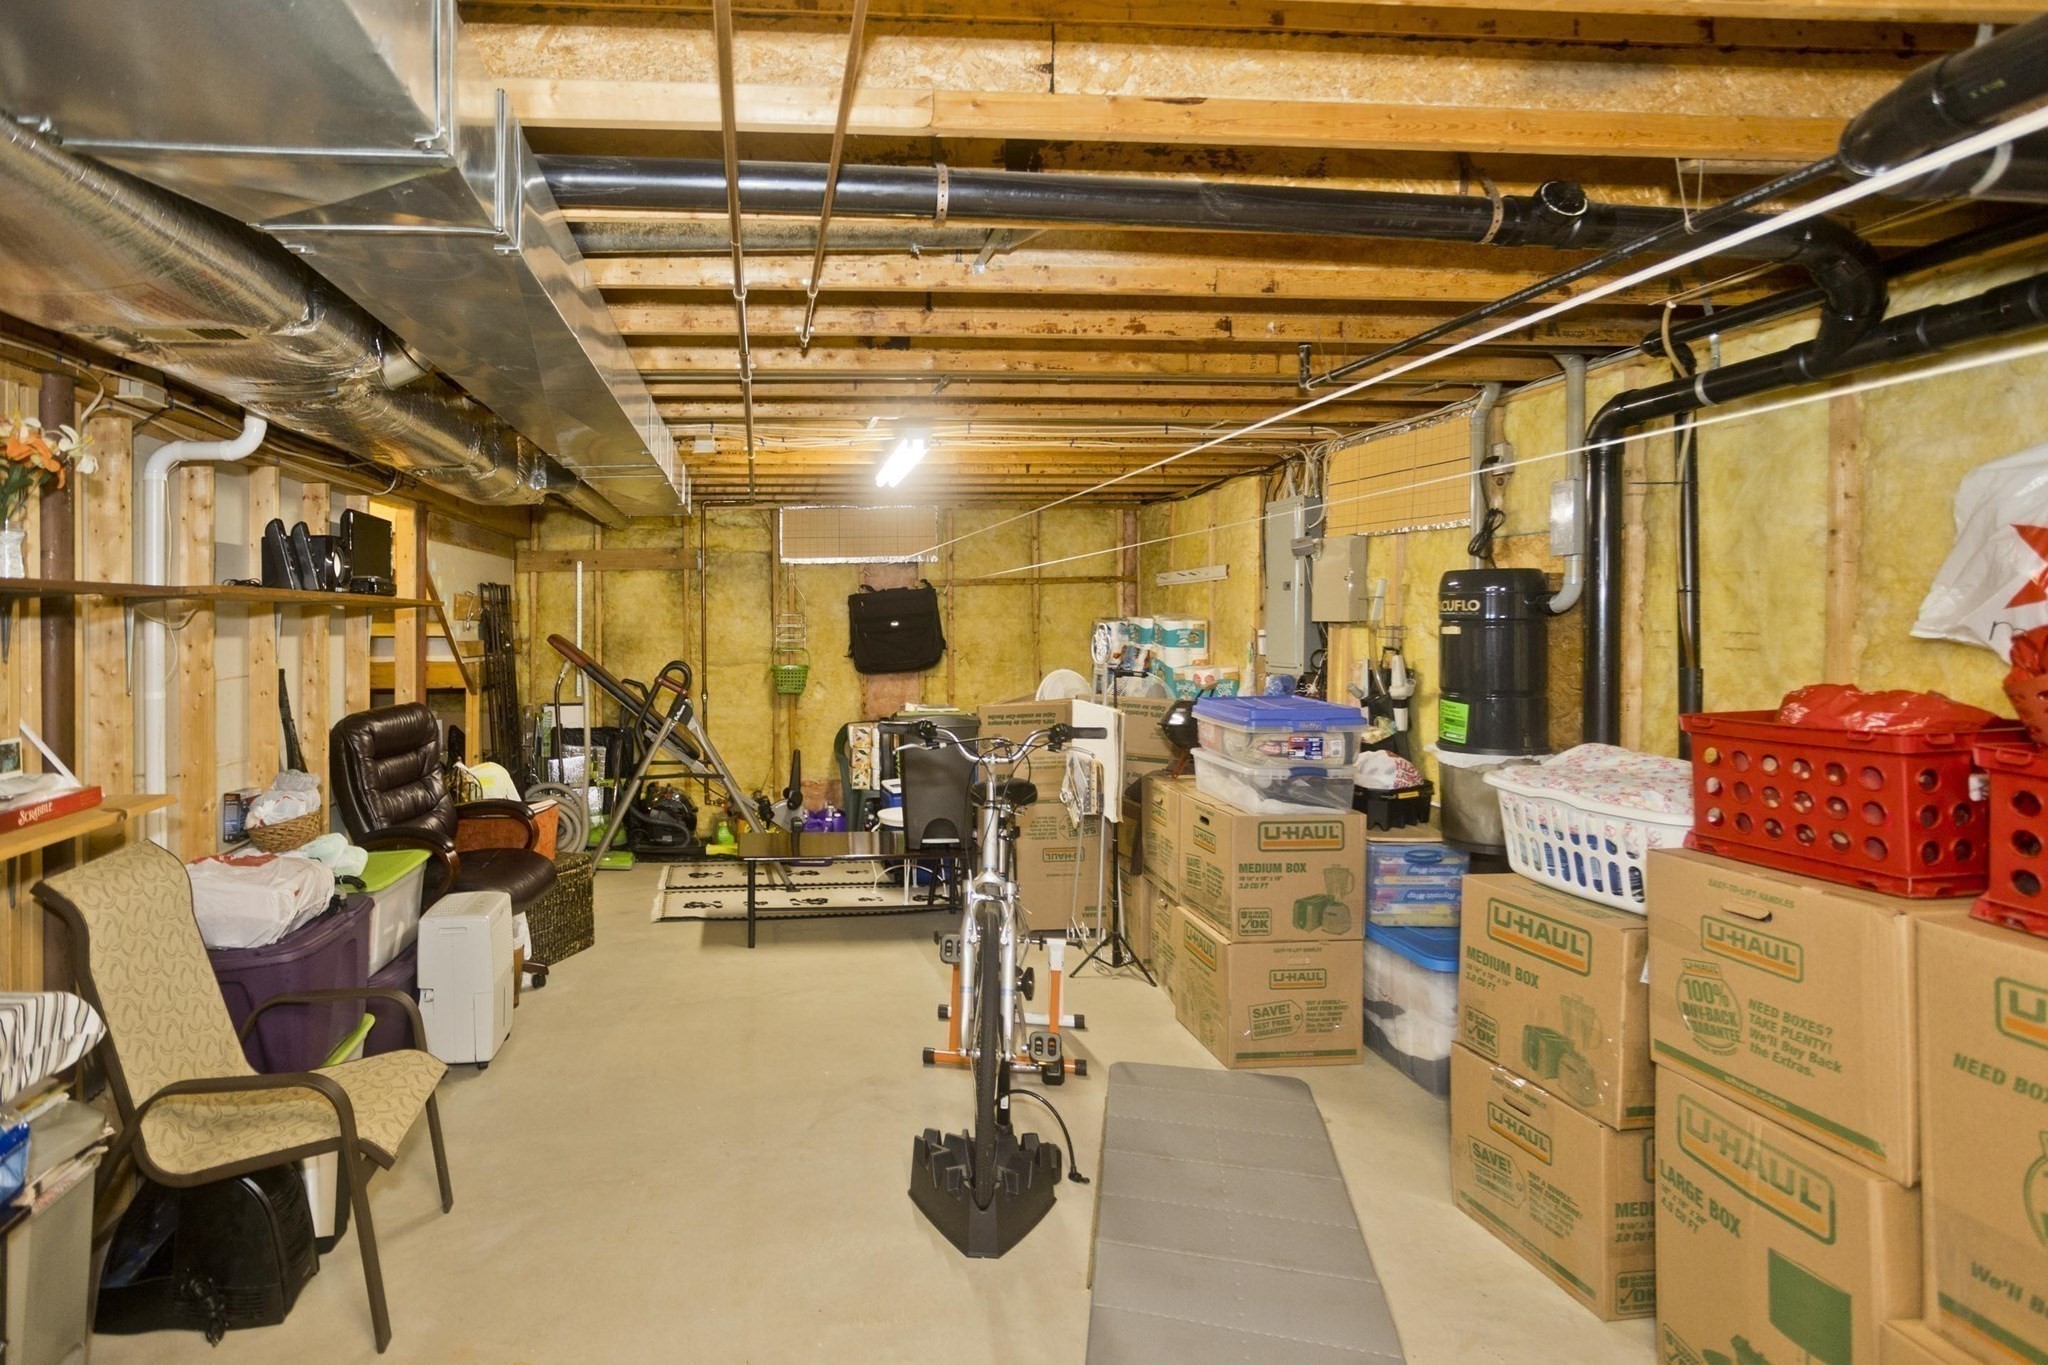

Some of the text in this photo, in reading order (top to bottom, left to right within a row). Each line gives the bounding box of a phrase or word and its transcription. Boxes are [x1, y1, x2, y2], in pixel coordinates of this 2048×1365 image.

[18, 802, 53, 826] SCRABBLE
[1263, 825, 1340, 840] U-HAUL
[1238, 862, 1307, 874] MEDIUM BOX
[1251, 920, 1269, 928] OK
[1493, 905, 1585, 957] U-HAUL
[1706, 922, 1797, 966] U-HAUL
[1273, 971, 1323, 982] U-HAUL
[1466, 945, 1539, 990] MEDIUM BOX
[1252, 1003, 1290, 1018] SAVE!
[1683, 978, 1729, 1008] 100%
[1681, 1001, 1738, 1028] BUY-BACK
[1748, 998, 1834, 1038] NEED BOXES?
[1477, 1028, 1496, 1047] OK
[1749, 1012, 1833, 1054] TAKE PLENTY!
[1749, 1027, 1777, 1047] We'll
[1781, 1040, 1806, 1060] Buy
[1808, 1051, 1842, 1074] Back
[1749, 1042, 1769, 1058] the
[1772, 1051, 1815, 1078] Extras.
[1952, 1052, 2006, 1086] NEED
[1491, 1108, 1548, 1153] U-HAUL
[1472, 1142, 1512, 1175] SAVE!
[1685, 1105, 1823, 1214] U-HAUL
[1660, 1158, 1741, 1239] LARGE BOX
[1970, 1260, 2024, 1302] We'll
